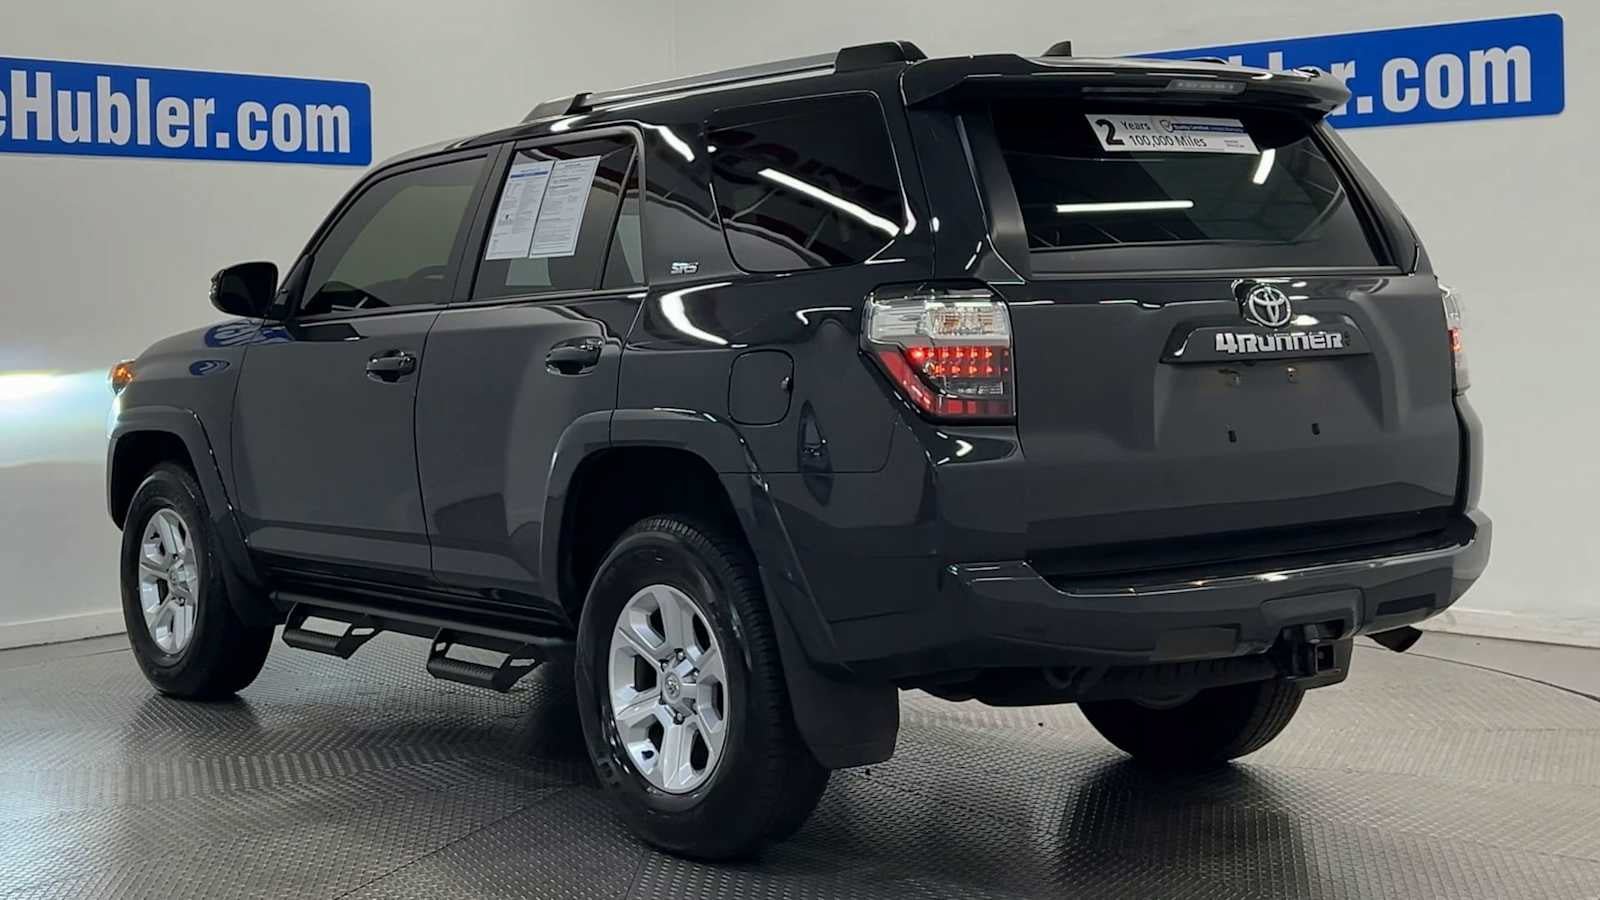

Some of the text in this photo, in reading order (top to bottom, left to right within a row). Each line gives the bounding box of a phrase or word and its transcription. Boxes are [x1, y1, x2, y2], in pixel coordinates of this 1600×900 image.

[0, 70, 350, 153] Hubler.com
[1095, 119, 1125, 146] 2
[1120, 120, 1151, 131] Years
[1129, 135, 1174, 148] 100,000
[1174, 135, 1208, 148] Miles
